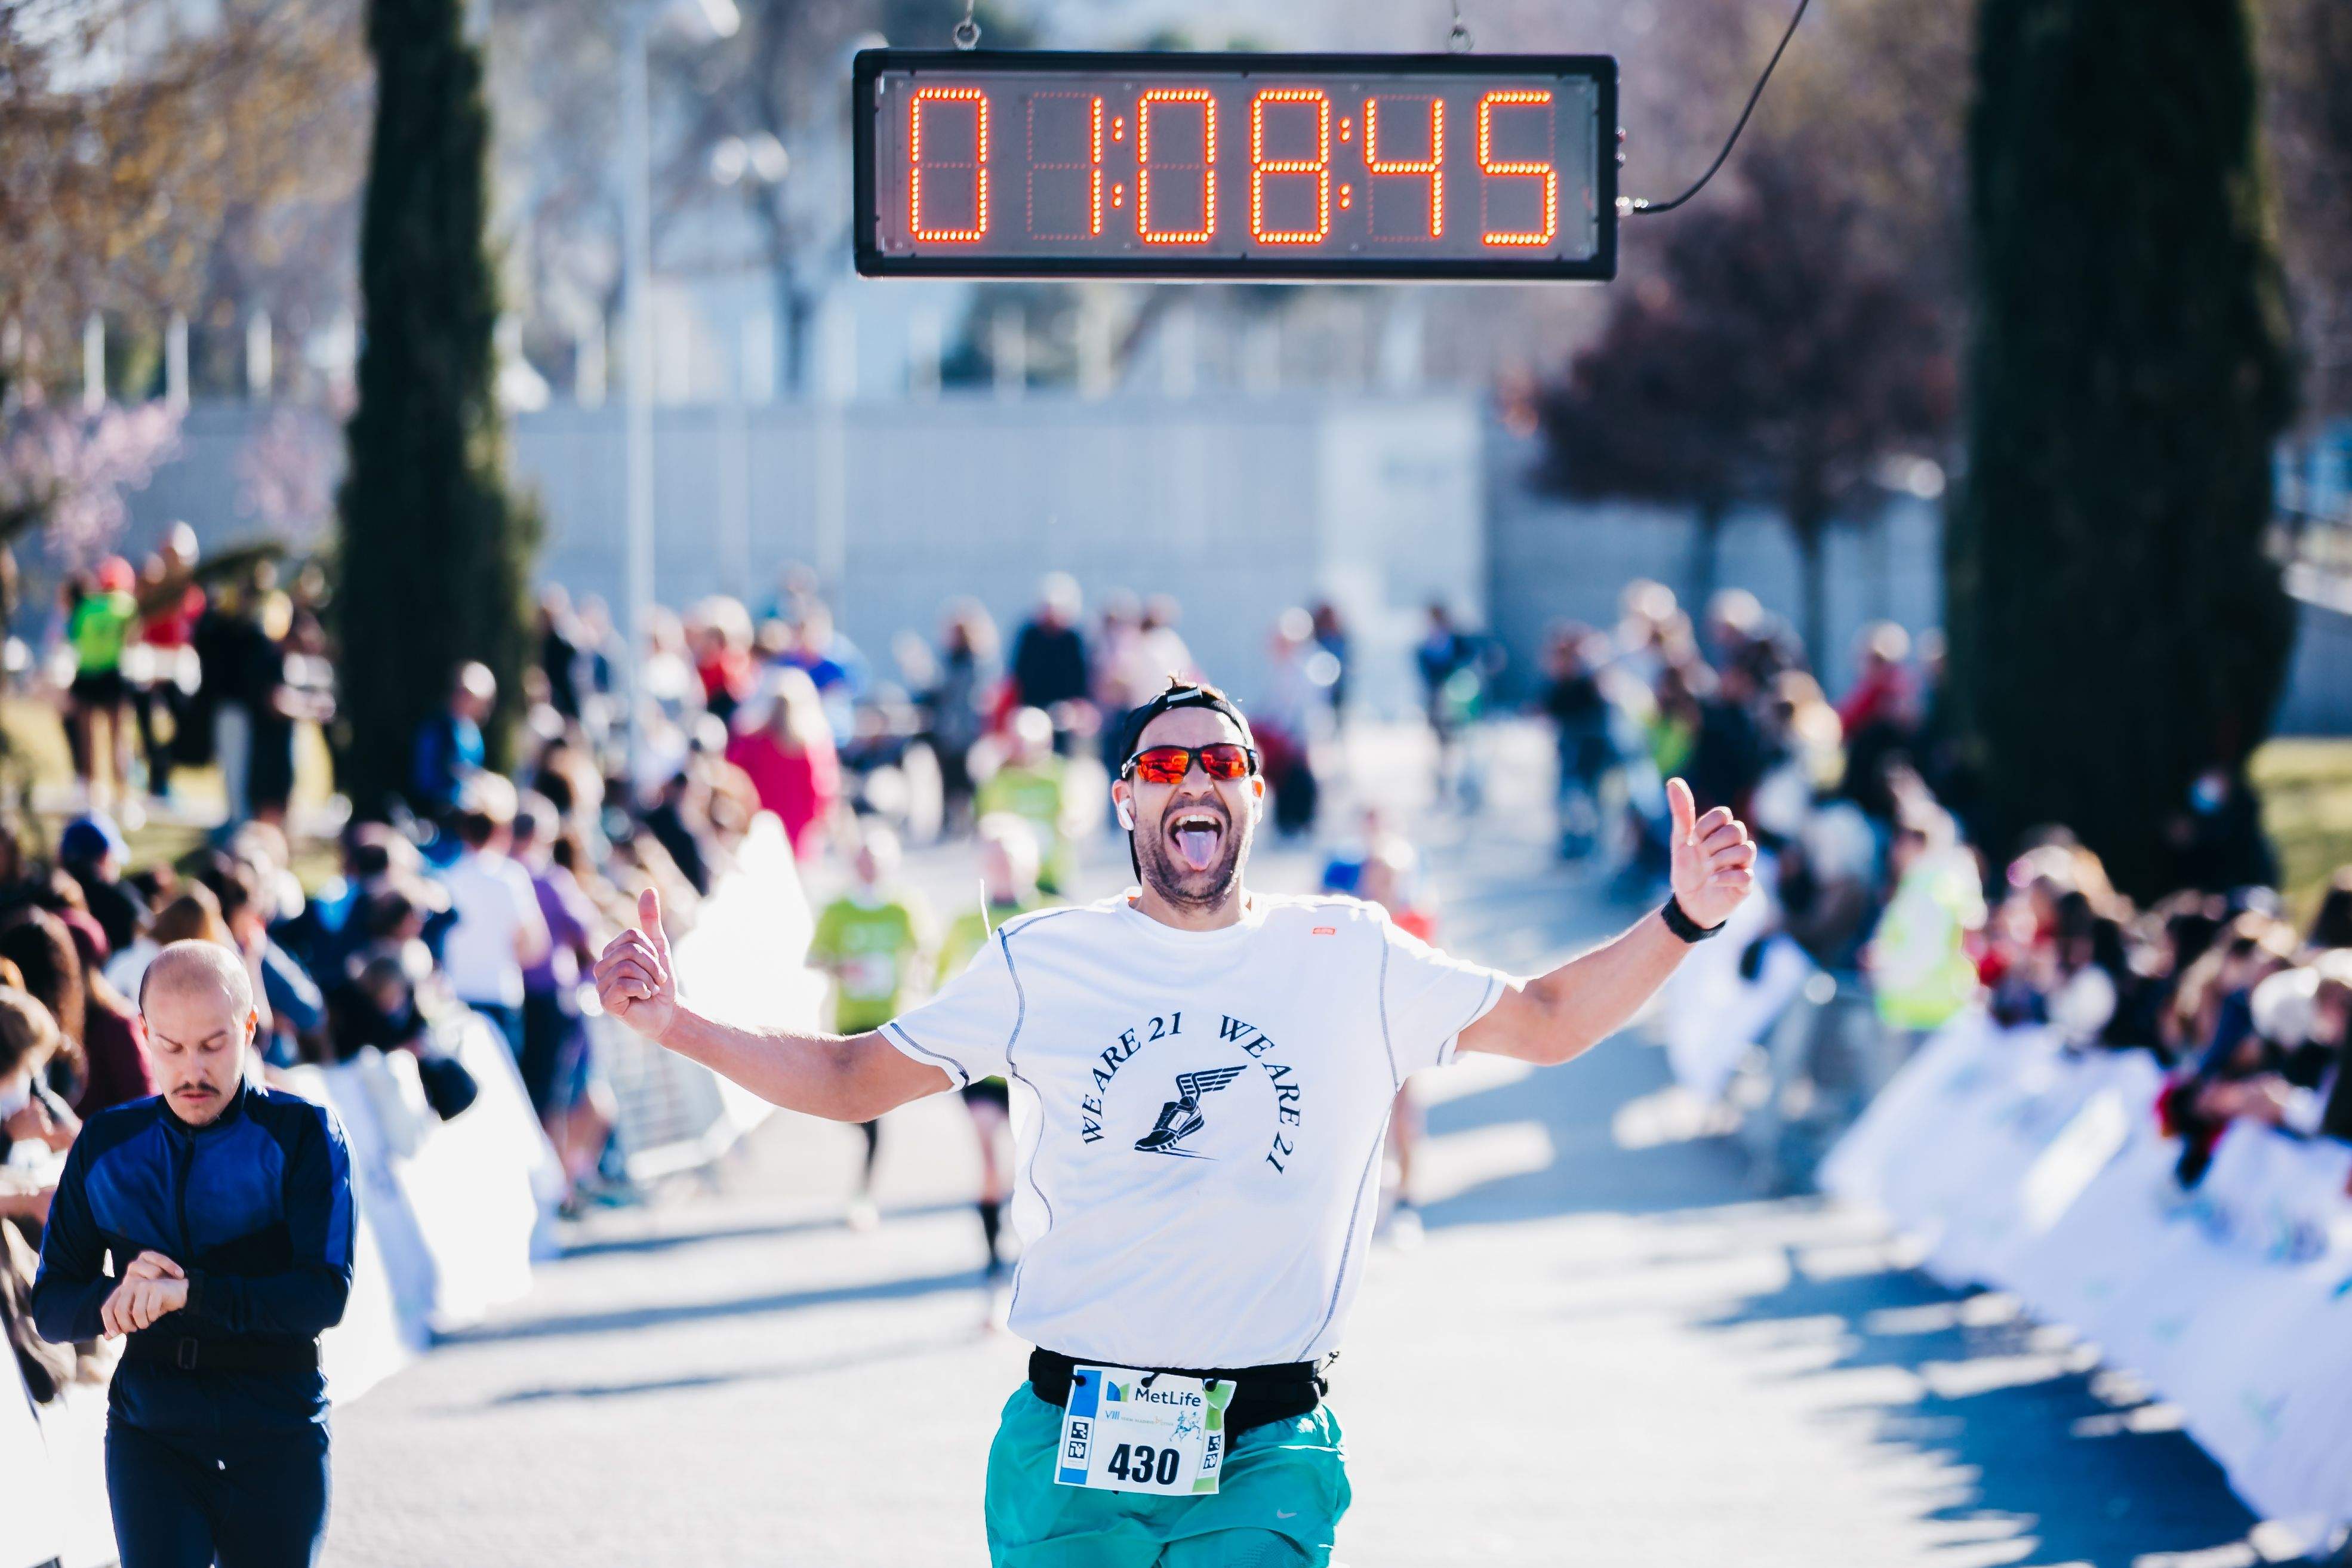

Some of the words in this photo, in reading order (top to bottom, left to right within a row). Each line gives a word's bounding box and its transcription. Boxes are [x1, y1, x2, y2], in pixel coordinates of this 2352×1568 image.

[1148, 1011, 1182, 1042] 21
[1220, 1014, 1276, 1059] WE
[1092, 1027, 1141, 1095] ARE
[1261, 1062, 1301, 1127] ARE
[1082, 1093, 1104, 1145] WE
[1266, 1131, 1294, 1175] 21
[1135, 1387, 1201, 1407] MetLife
[1107, 1443, 1180, 1485] 430
